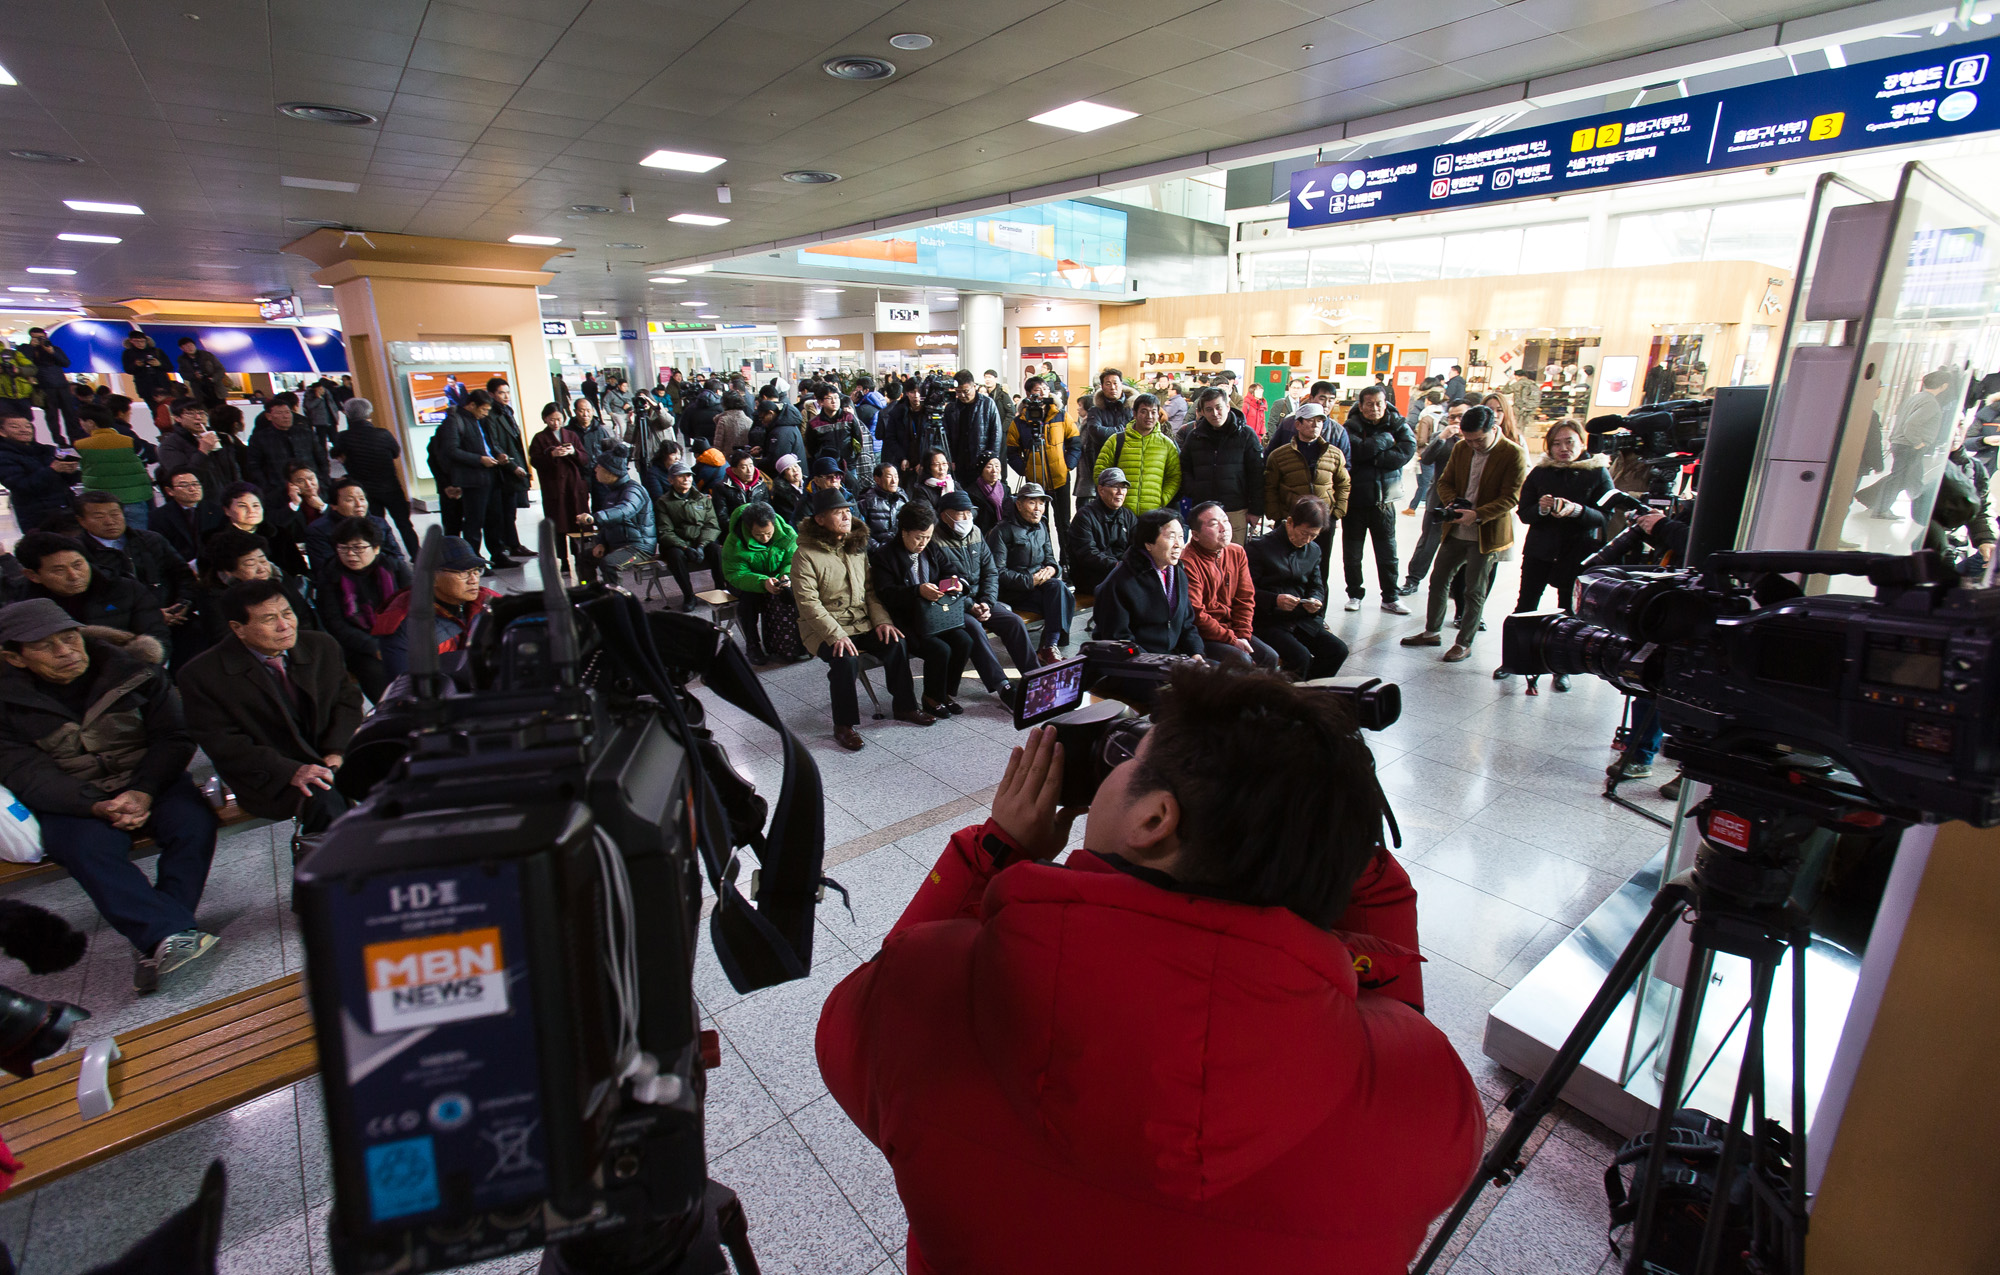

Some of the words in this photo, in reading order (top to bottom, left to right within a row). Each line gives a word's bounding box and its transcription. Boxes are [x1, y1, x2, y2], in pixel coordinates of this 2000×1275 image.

[1883, 66, 1944, 90] 공항철도
[1890, 99, 1937, 120] 경의선
[1820, 118, 1833, 136] 3
[1909, 116, 1930, 125] Line
[1580, 133, 1586, 148] 1
[1603, 127, 1615, 143] 2
[1733, 120, 1808, 144] 출입구(서부)
[1566, 146, 1657, 170] 서울지방철도경찰대
[1034, 329, 1075, 344] 수유방
[409, 346, 495, 361] SAMSUNG
[1712, 825, 1744, 841] NEWS
[374, 942, 495, 988] MBN
[393, 977, 484, 1008] NEWS
